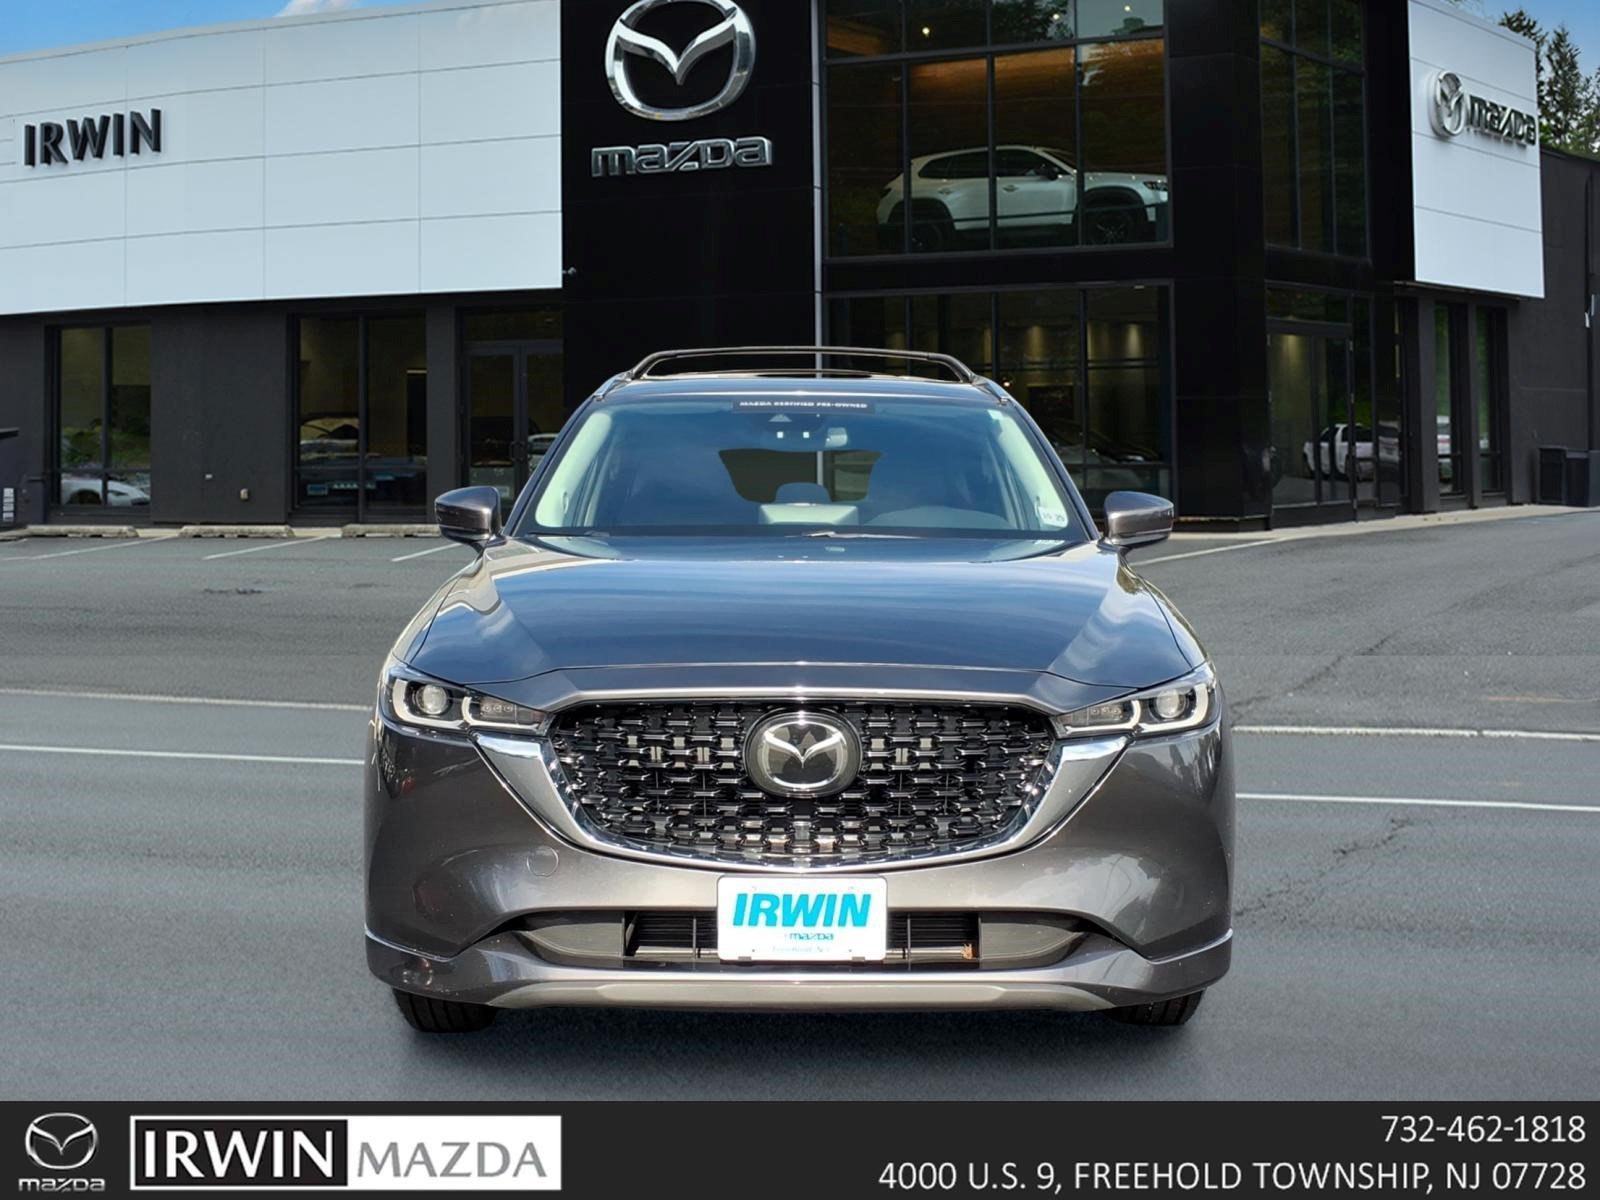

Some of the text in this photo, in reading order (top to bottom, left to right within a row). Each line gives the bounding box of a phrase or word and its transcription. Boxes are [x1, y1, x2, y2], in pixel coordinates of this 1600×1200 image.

[25, 108, 162, 168] IRWIN
[591, 135, 773, 178] mazda
[732, 893, 872, 927] IRWIN
